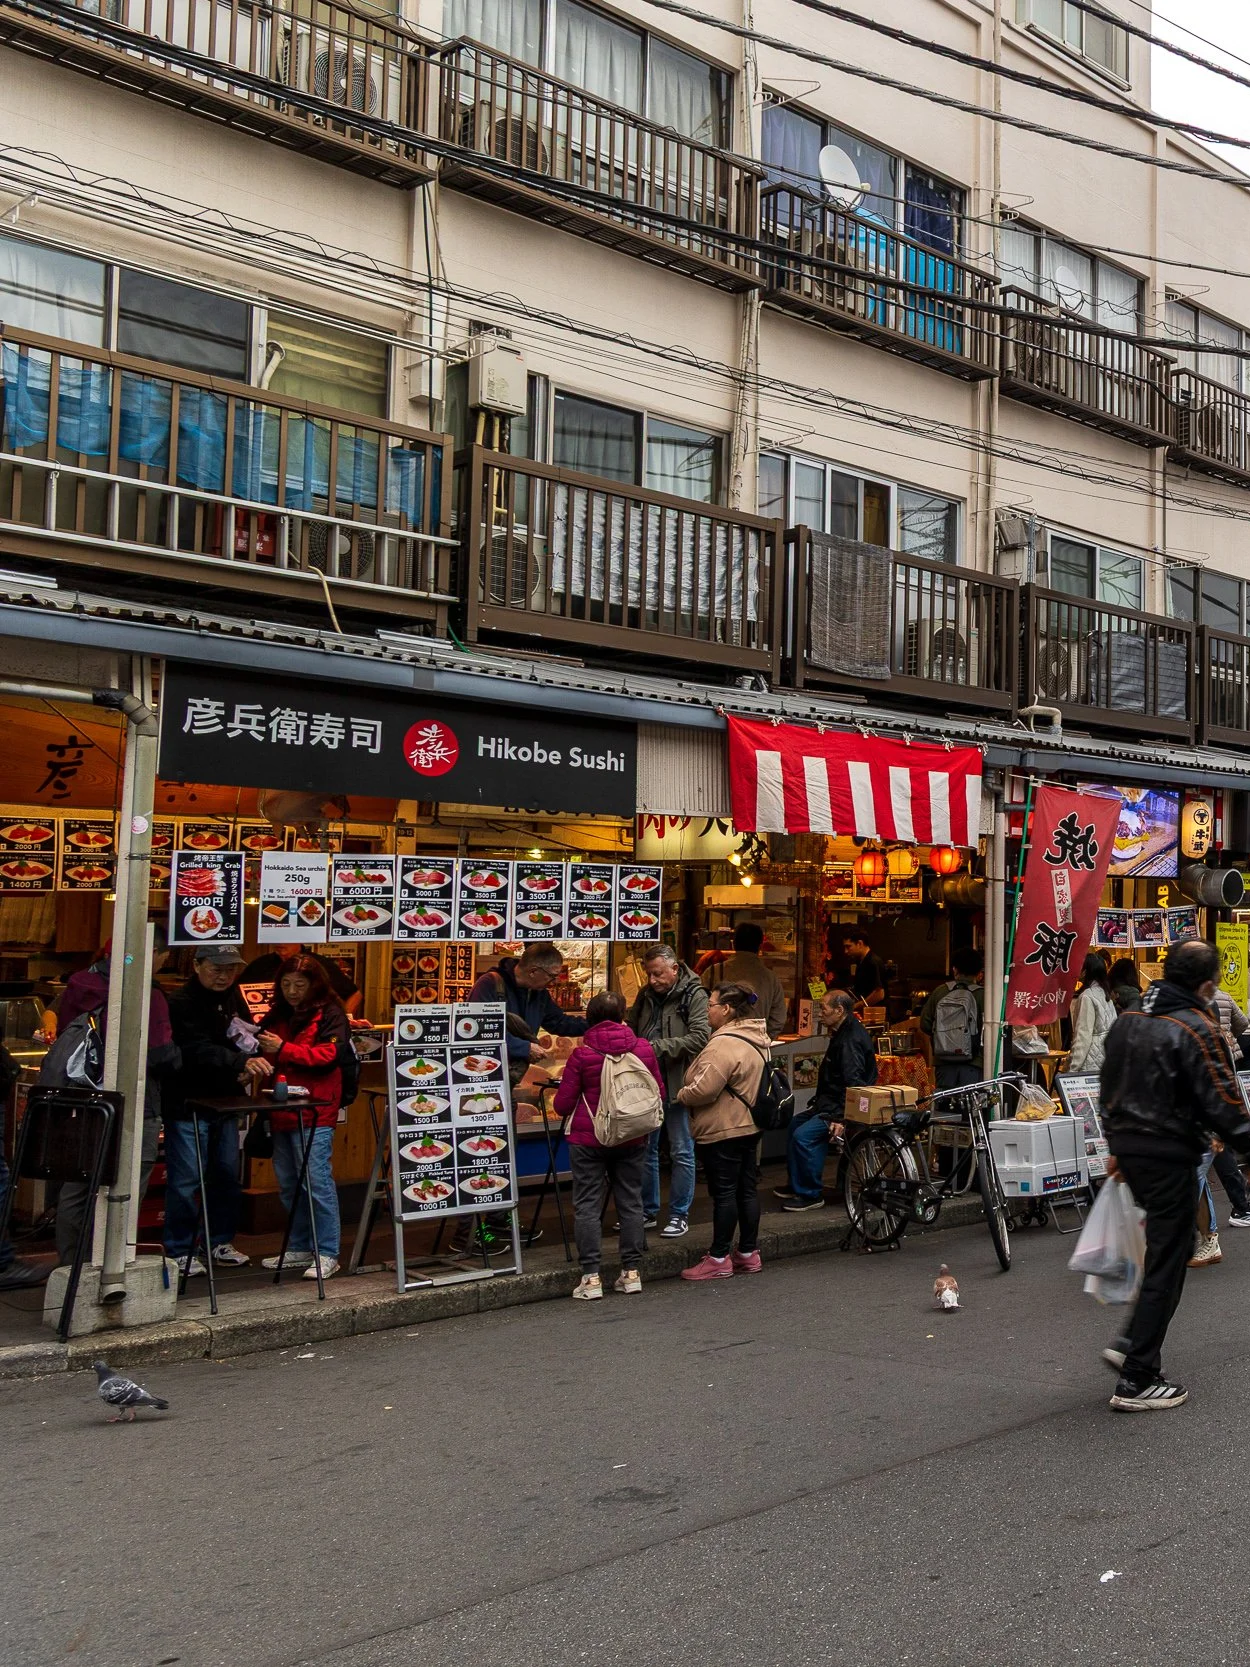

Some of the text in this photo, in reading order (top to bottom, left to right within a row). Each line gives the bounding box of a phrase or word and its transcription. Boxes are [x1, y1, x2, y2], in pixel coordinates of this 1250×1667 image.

[182, 697, 383, 754] 彦兵衛寿司
[477, 736, 625, 772] Hikobe Sushi
[34, 735, 95, 799] 彦
[34, 843, 41, 851] 円
[206, 862, 221, 870] king
[284, 874, 310, 884] 250g
[230, 870, 238, 915] 焼きタラバガニ
[349, 887, 371, 895] 6000
[374, 887, 382, 895] 円
[182, 897, 223, 906] 6800 円
[644, 930, 651, 938] 円
[441, 1034, 449, 1042] 円
[418, 1203, 438, 1211] 1000
